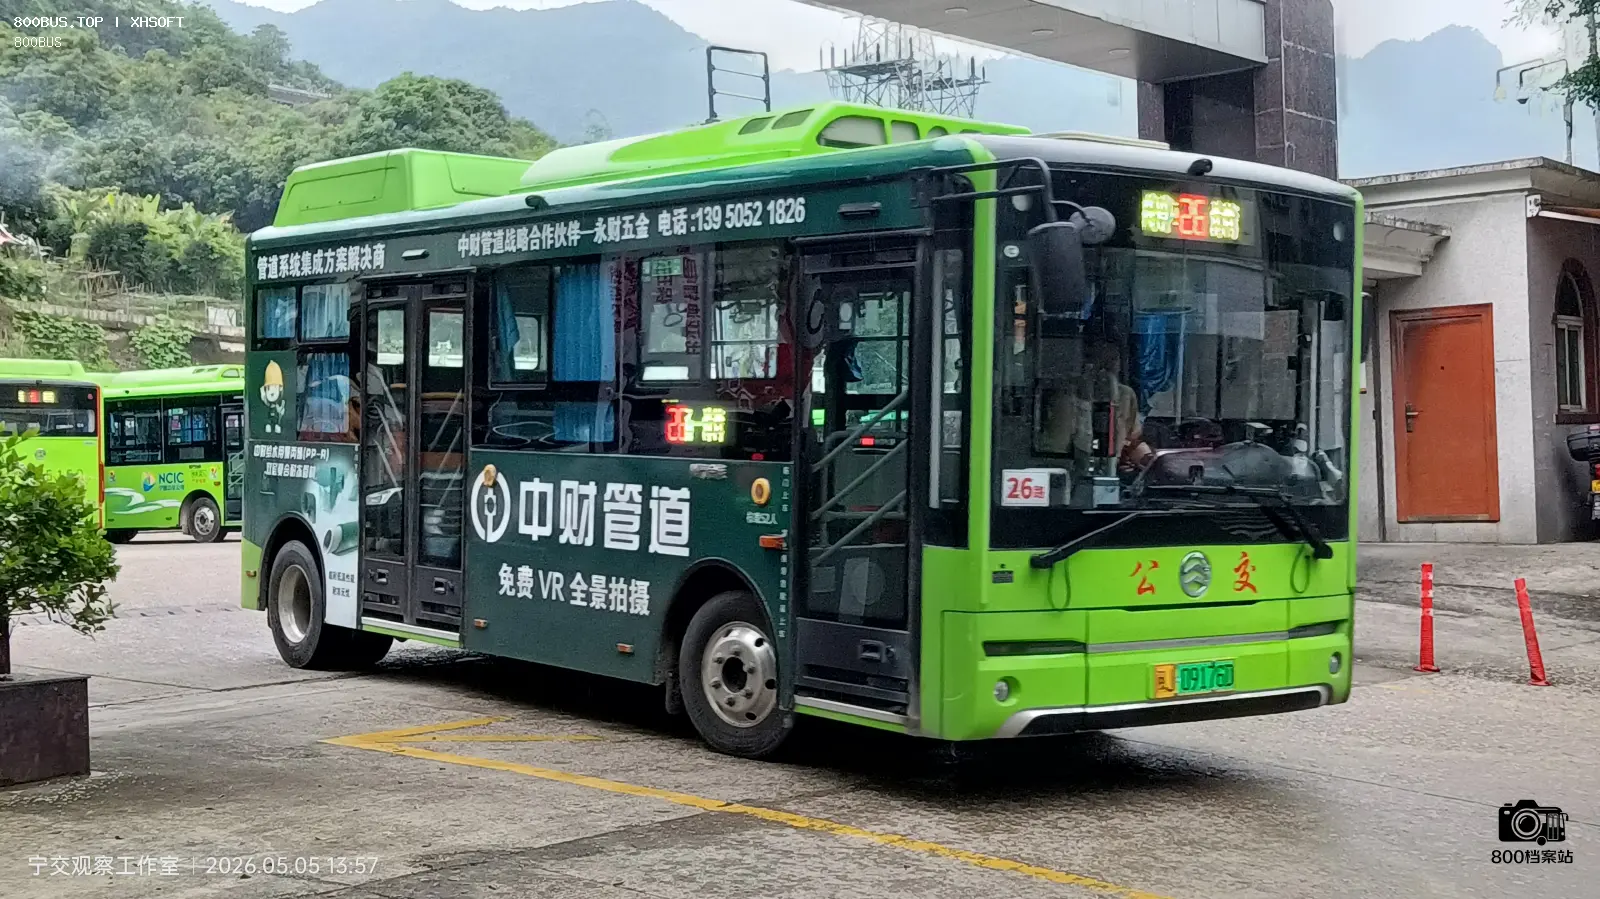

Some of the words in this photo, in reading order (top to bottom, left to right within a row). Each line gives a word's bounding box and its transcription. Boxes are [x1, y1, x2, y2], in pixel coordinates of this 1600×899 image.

[725, 201, 763, 229] 5052
[766, 197, 806, 226] 1826
[257, 243, 386, 280] 管道系统集成方案解决商
[158, 472, 184, 484] NCIC
[517, 477, 691, 557] 中财管道
